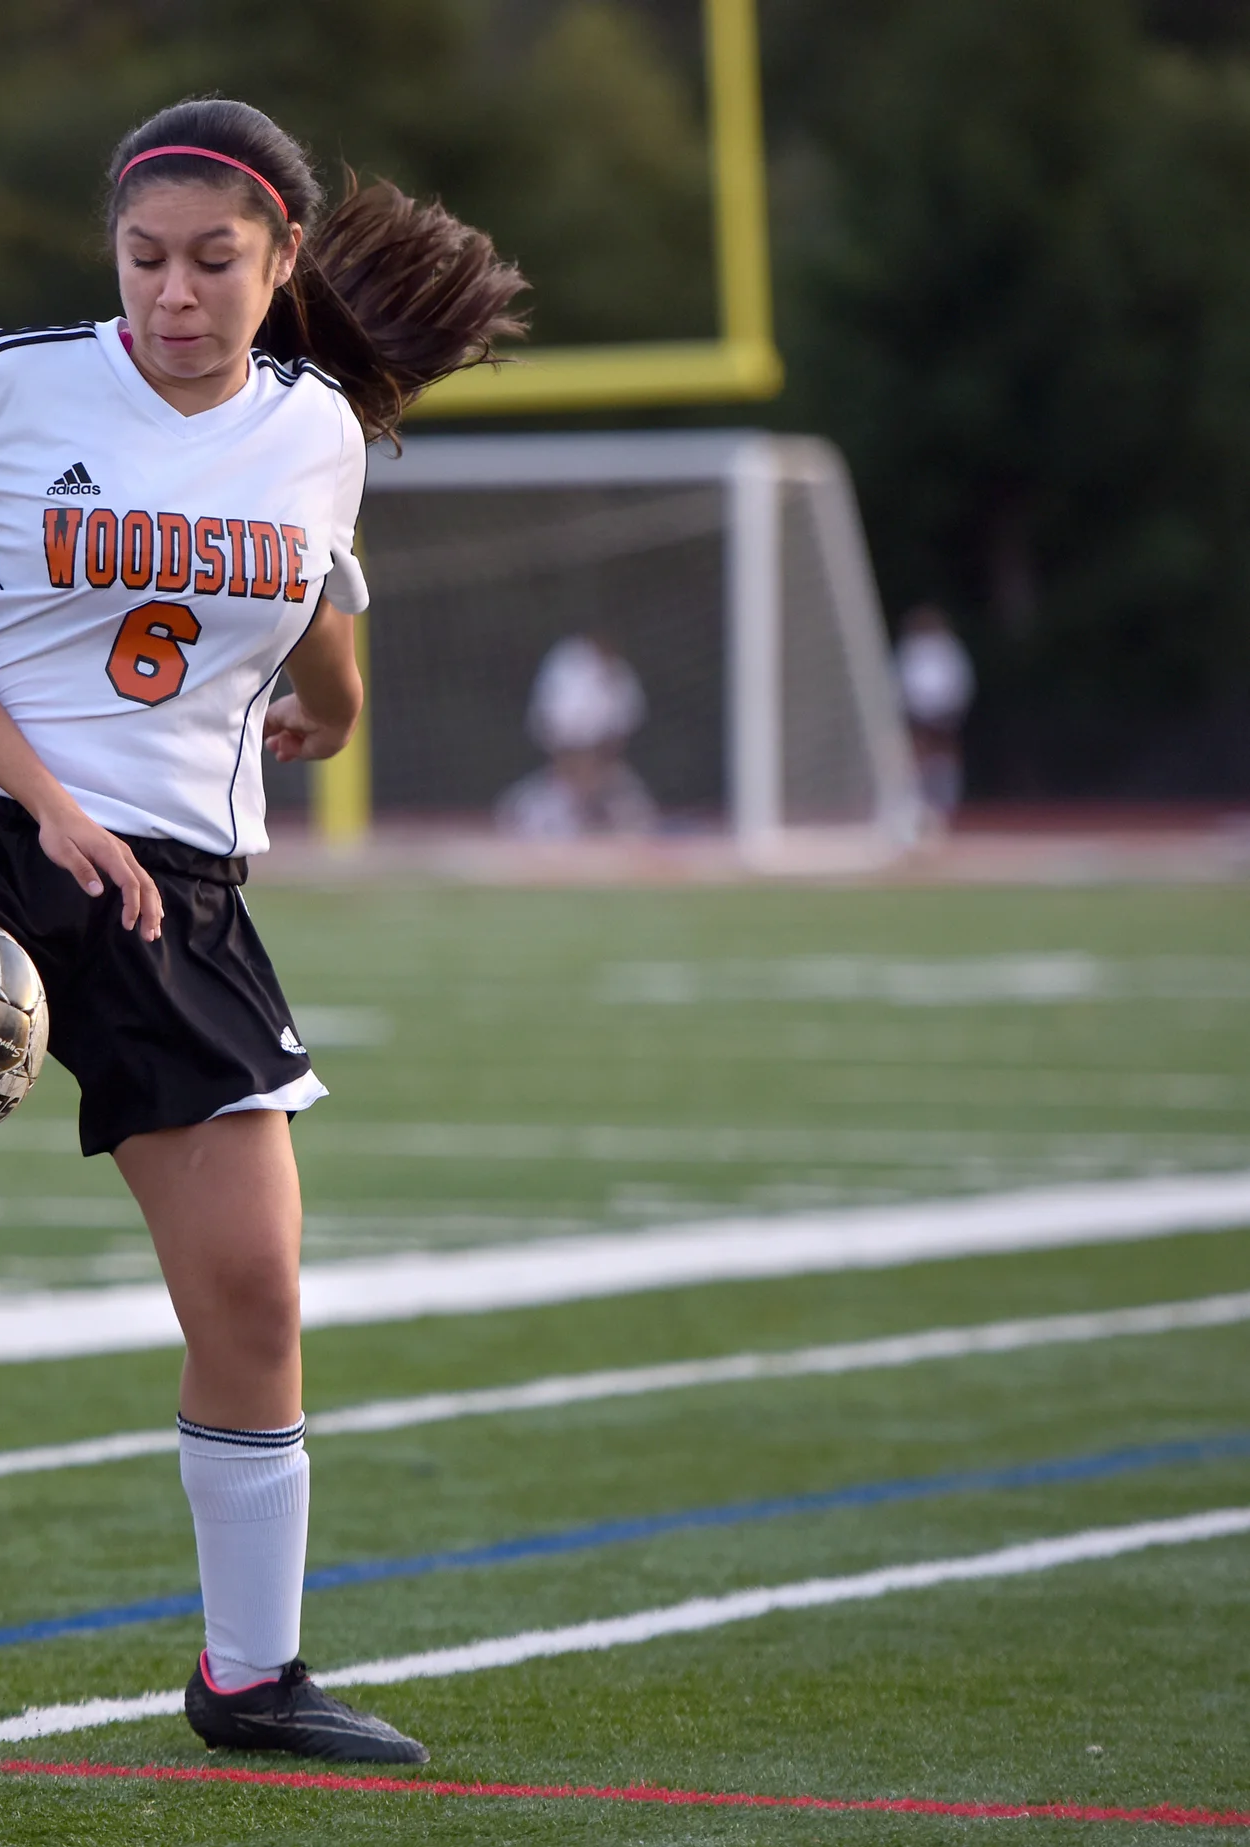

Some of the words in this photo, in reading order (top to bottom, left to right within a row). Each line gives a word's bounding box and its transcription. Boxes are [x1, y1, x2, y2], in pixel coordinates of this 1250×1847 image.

[46, 483, 101, 495] adidas
[43, 508, 309, 603] WOODSIDE
[105, 600, 202, 707] 6
